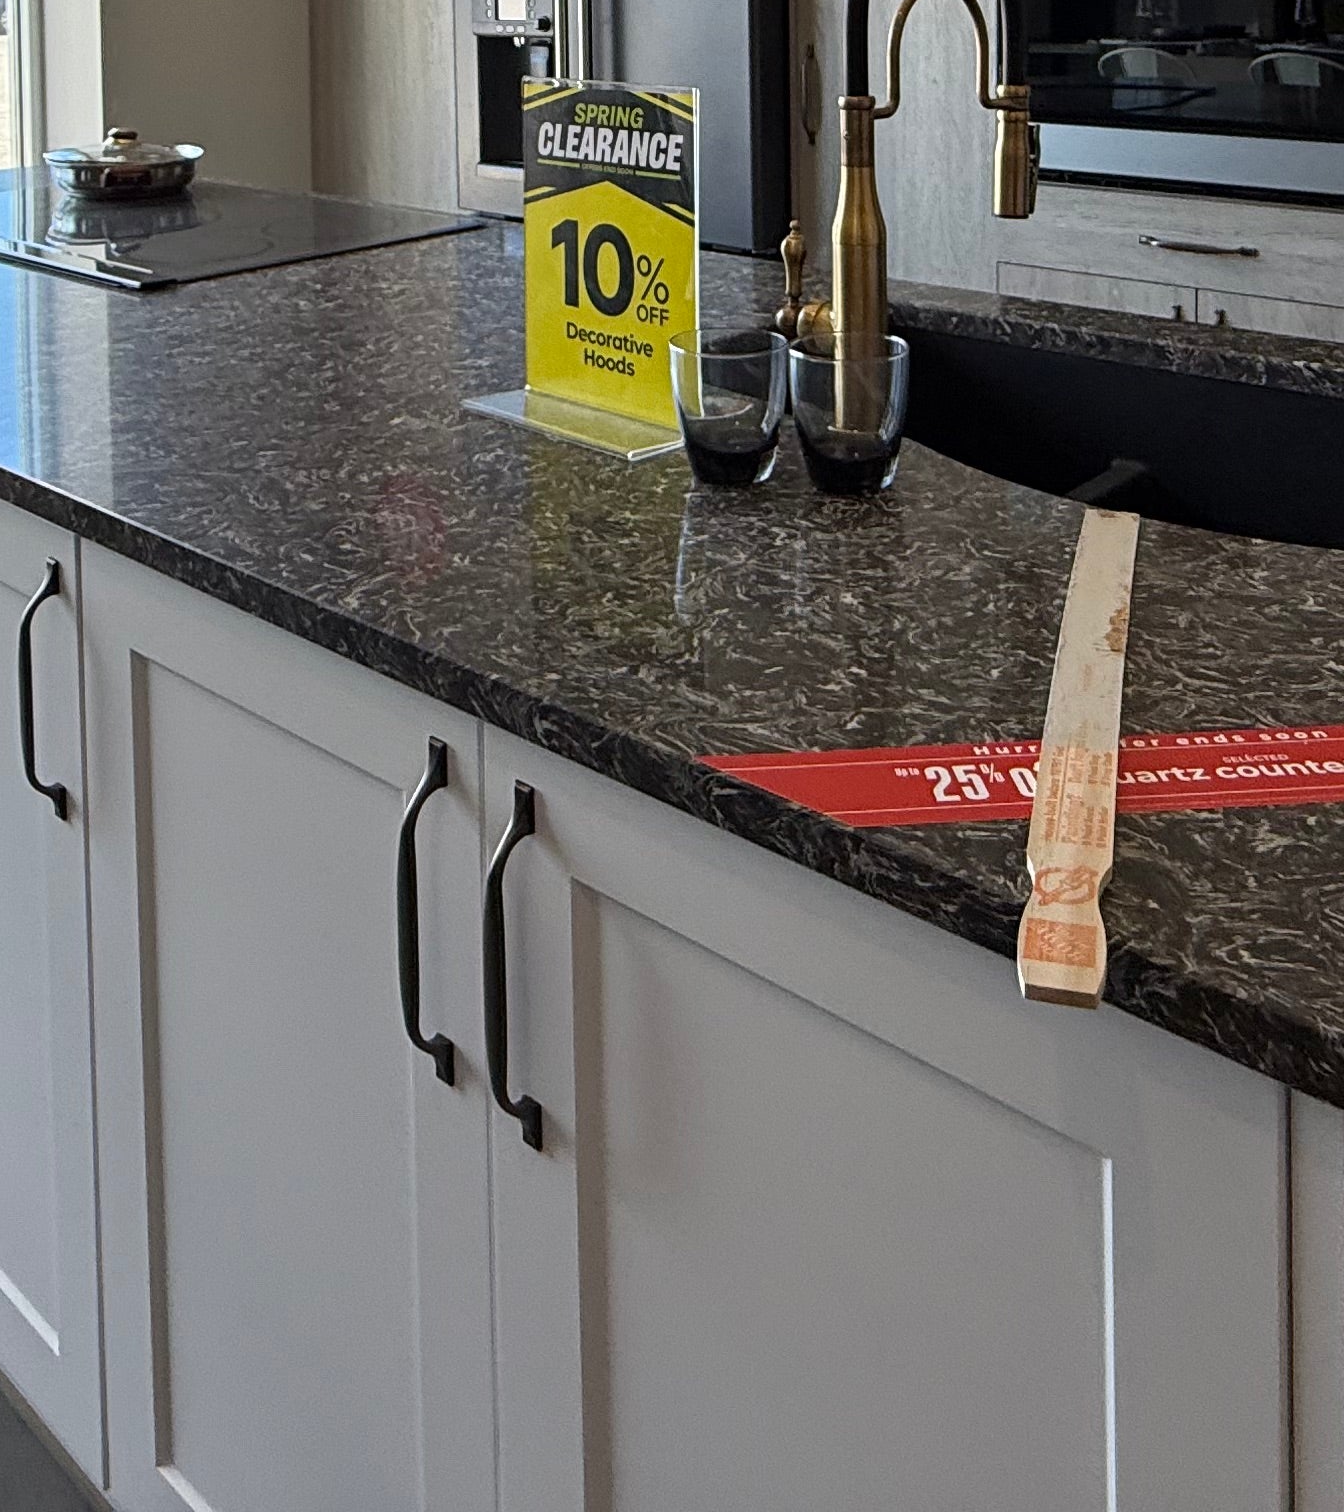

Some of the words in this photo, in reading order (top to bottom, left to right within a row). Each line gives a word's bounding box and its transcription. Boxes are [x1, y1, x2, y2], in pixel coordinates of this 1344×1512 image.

[574, 102, 645, 129] SPRING
[537, 121, 684, 172] CLEARANCE
[551, 218, 670, 317] 10%
[636, 303, 670, 326] OFF
[566, 321, 654, 358] Decorative
[583, 347, 636, 377] Hoods
[972, 745, 1038, 756] Hurr
[1175, 733, 1245, 746] ends
[1258, 730, 1328, 743] soon
[1222, 753, 1289, 764] SELECTED
[924, 762, 1006, 802] 25%
[1116, 767, 1212, 784] uartz
